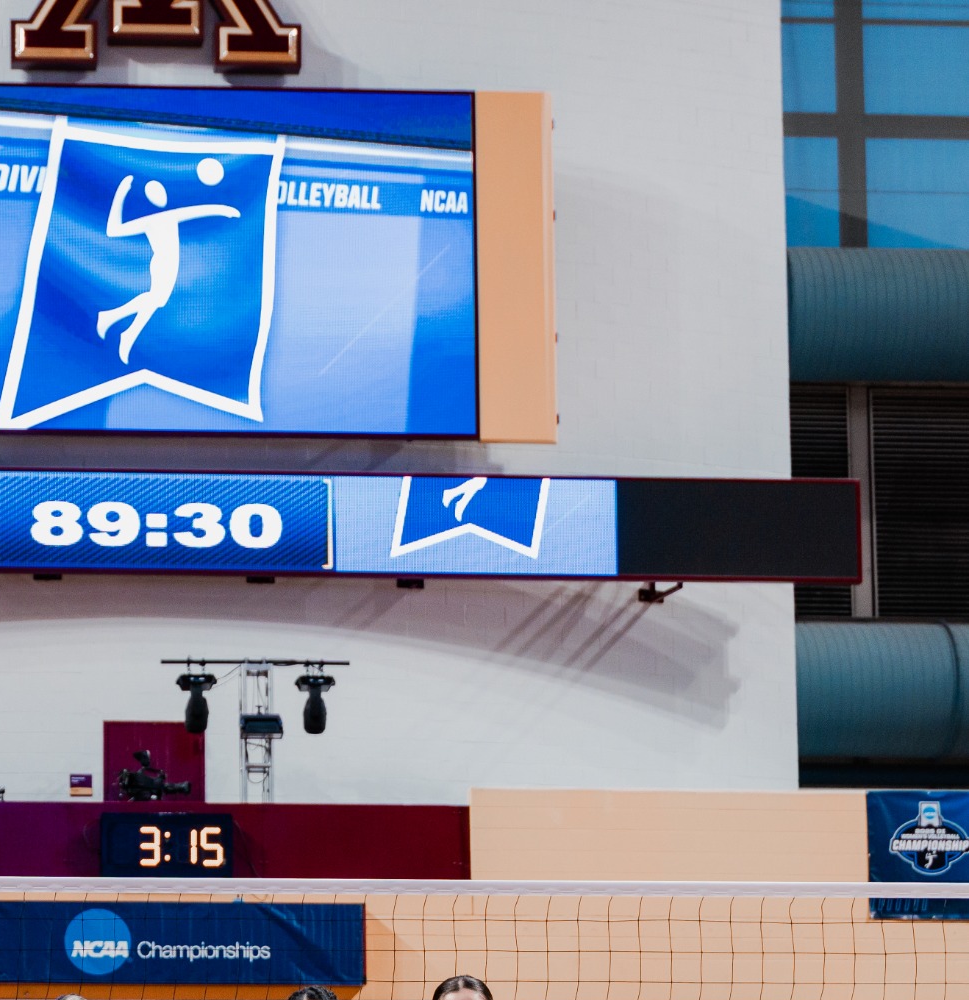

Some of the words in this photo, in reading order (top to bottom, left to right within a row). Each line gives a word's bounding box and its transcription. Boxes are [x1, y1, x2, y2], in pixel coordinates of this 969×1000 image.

[420, 189, 468, 214] NCAA
[30, 500, 283, 549] 89:30
[139, 826, 224, 867] 3:15
[892, 840, 969, 851] CHAMPIONSHIP
[71, 940, 129, 958] NCAA
[137, 940, 271, 962] Championships
